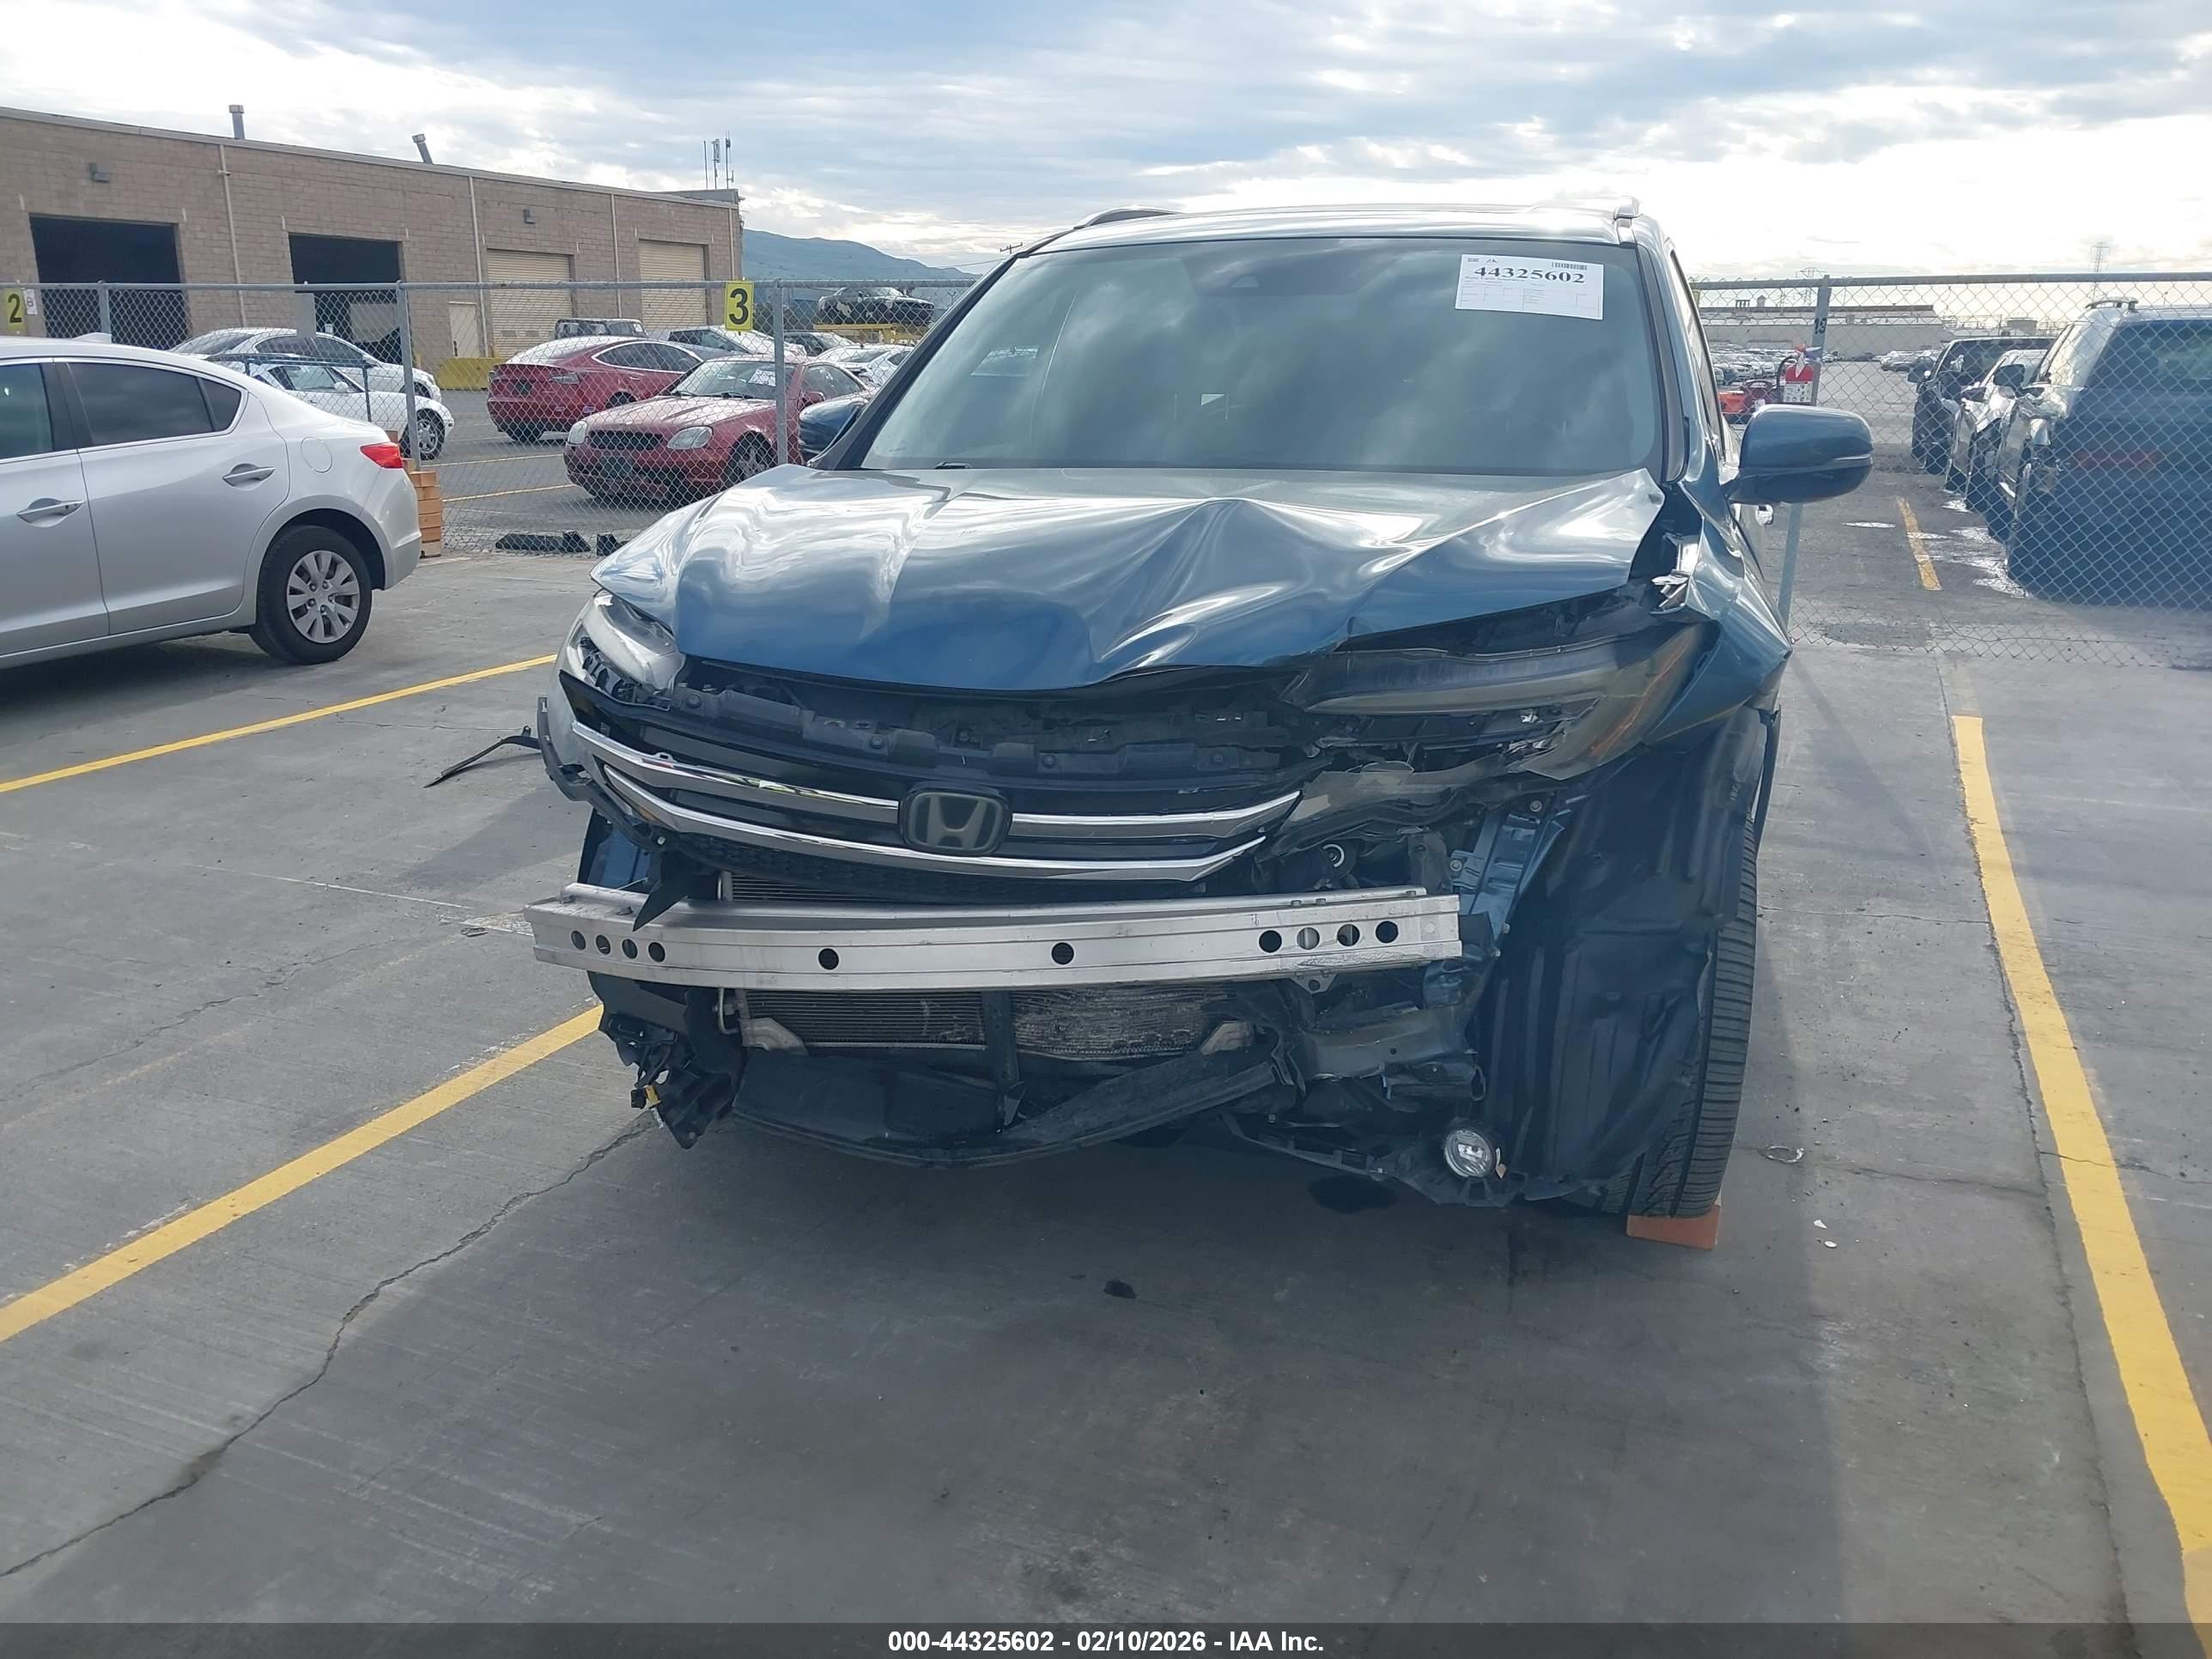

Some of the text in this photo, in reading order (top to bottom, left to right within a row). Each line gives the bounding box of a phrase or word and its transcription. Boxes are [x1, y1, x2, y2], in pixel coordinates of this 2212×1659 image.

[1474, 267, 1585, 283] 44325602
[8, 293, 22, 324] 2
[729, 288, 749, 325] 3
